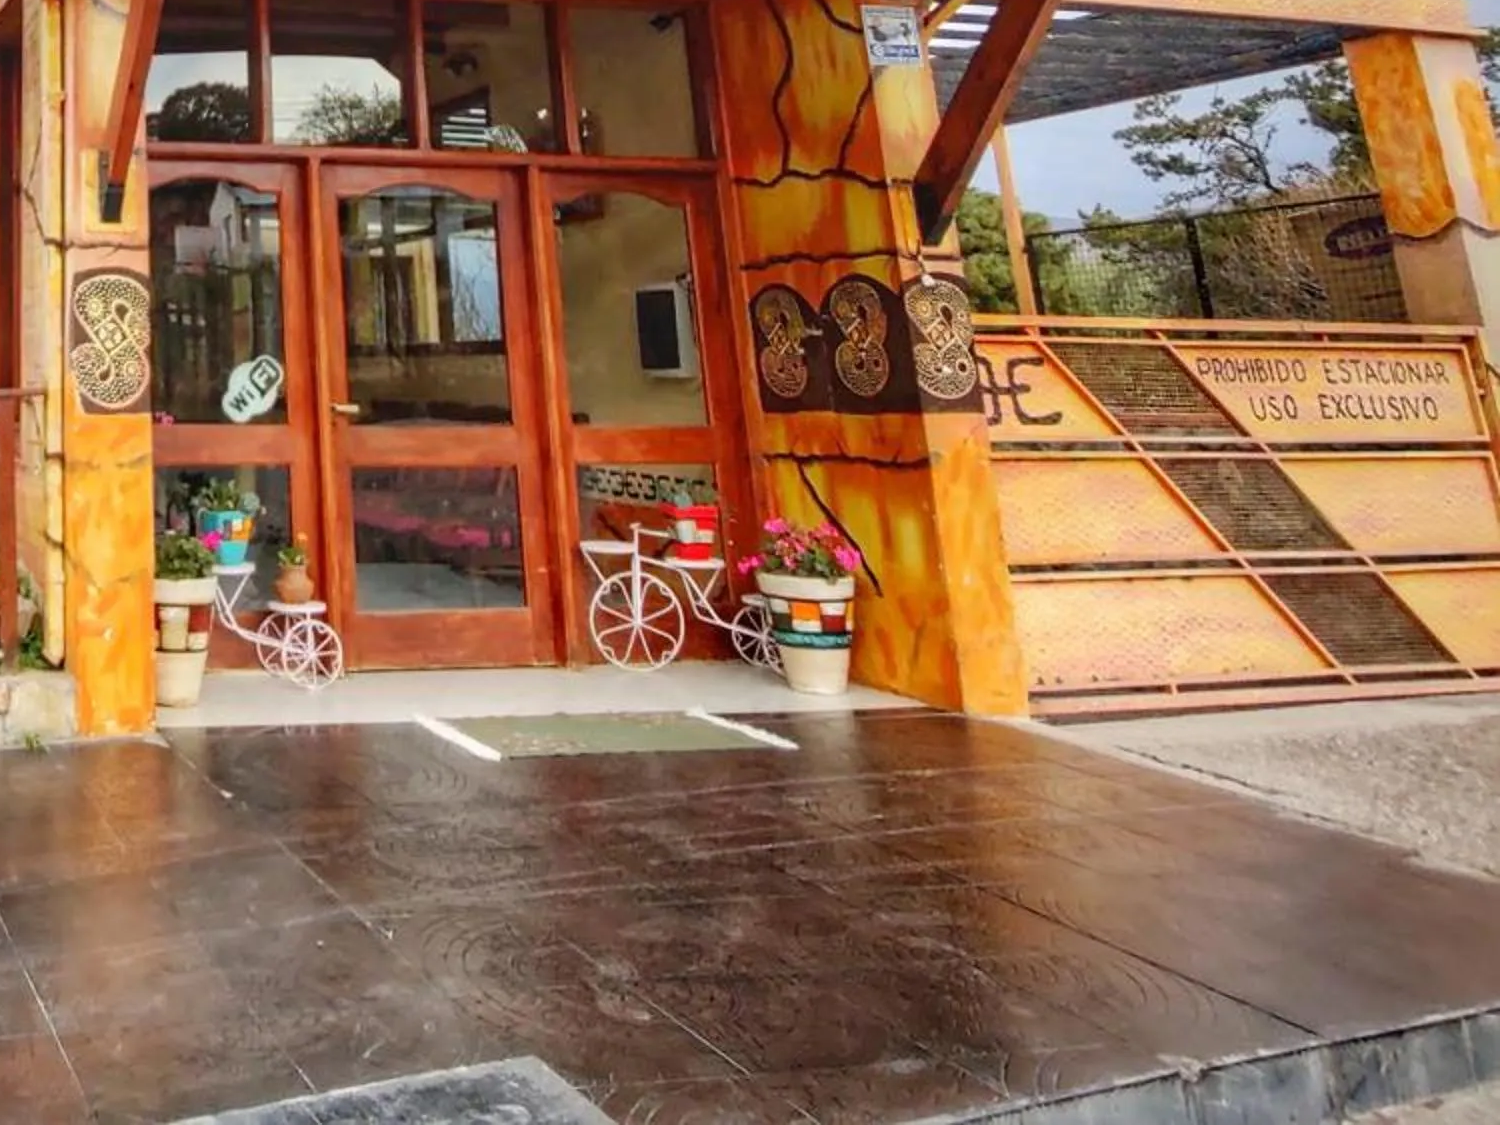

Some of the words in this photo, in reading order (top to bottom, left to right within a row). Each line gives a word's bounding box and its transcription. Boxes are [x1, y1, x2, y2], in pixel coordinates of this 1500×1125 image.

[1195, 357, 1308, 384] PROHIBIDO
[1322, 358, 1449, 385] ESTACIONAR
[1249, 394, 1299, 421] USO
[1319, 393, 1439, 421] EXCLUSIVO
